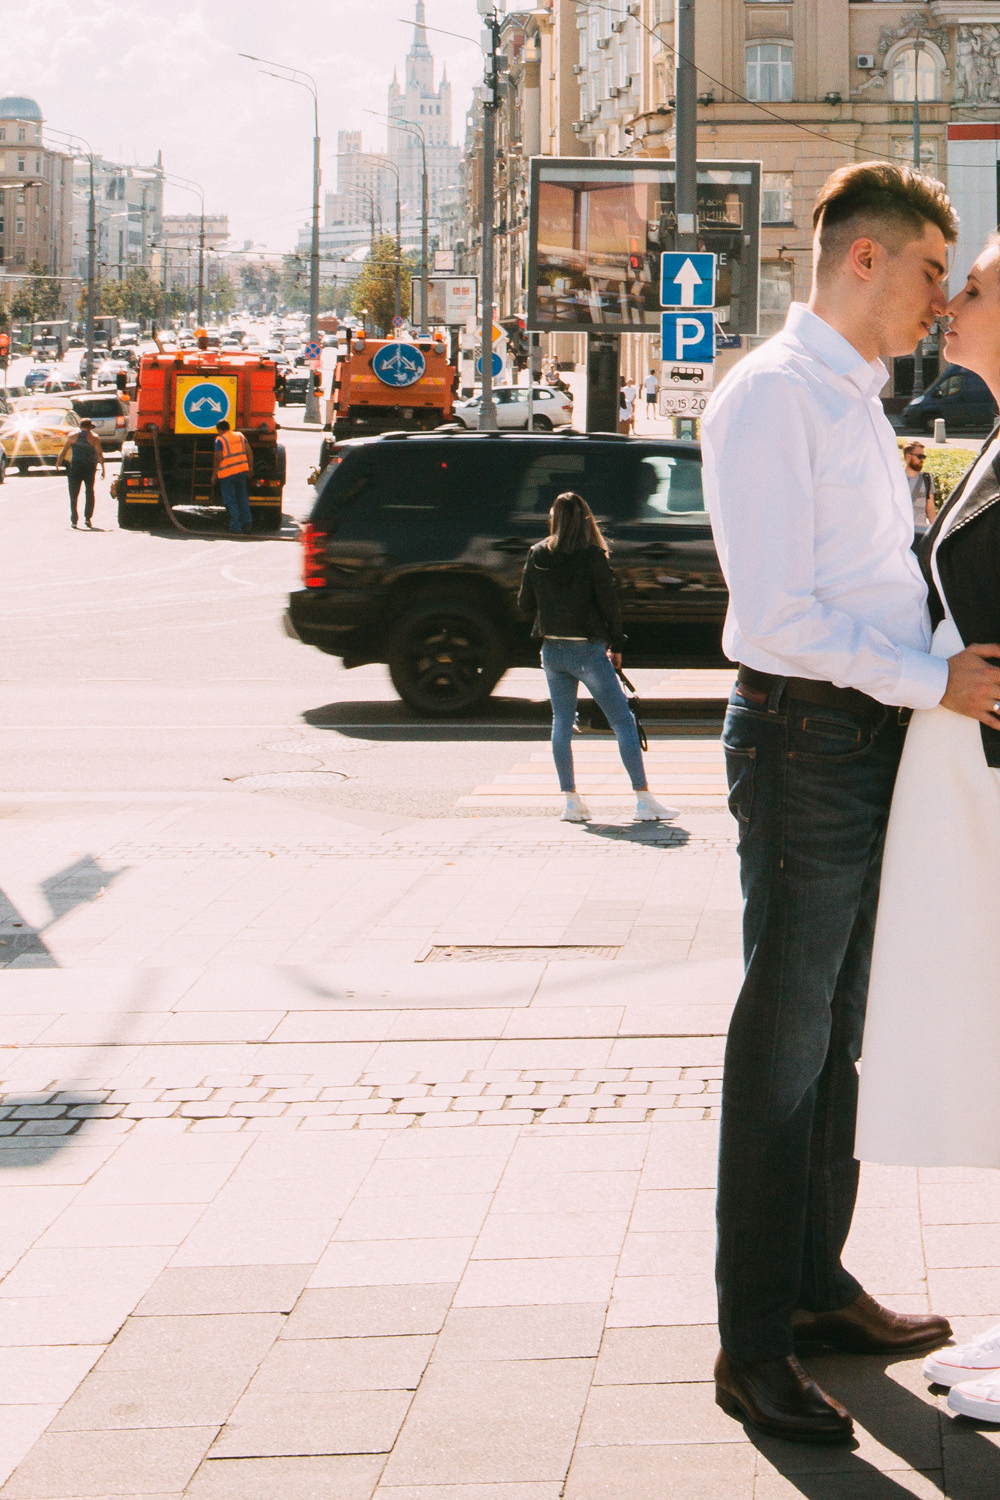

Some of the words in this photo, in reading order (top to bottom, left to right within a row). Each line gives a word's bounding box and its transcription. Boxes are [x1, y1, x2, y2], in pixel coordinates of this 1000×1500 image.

[676, 318, 705, 360] P
[666, 400, 675, 408] 10
[691, 398, 707, 410] 20
